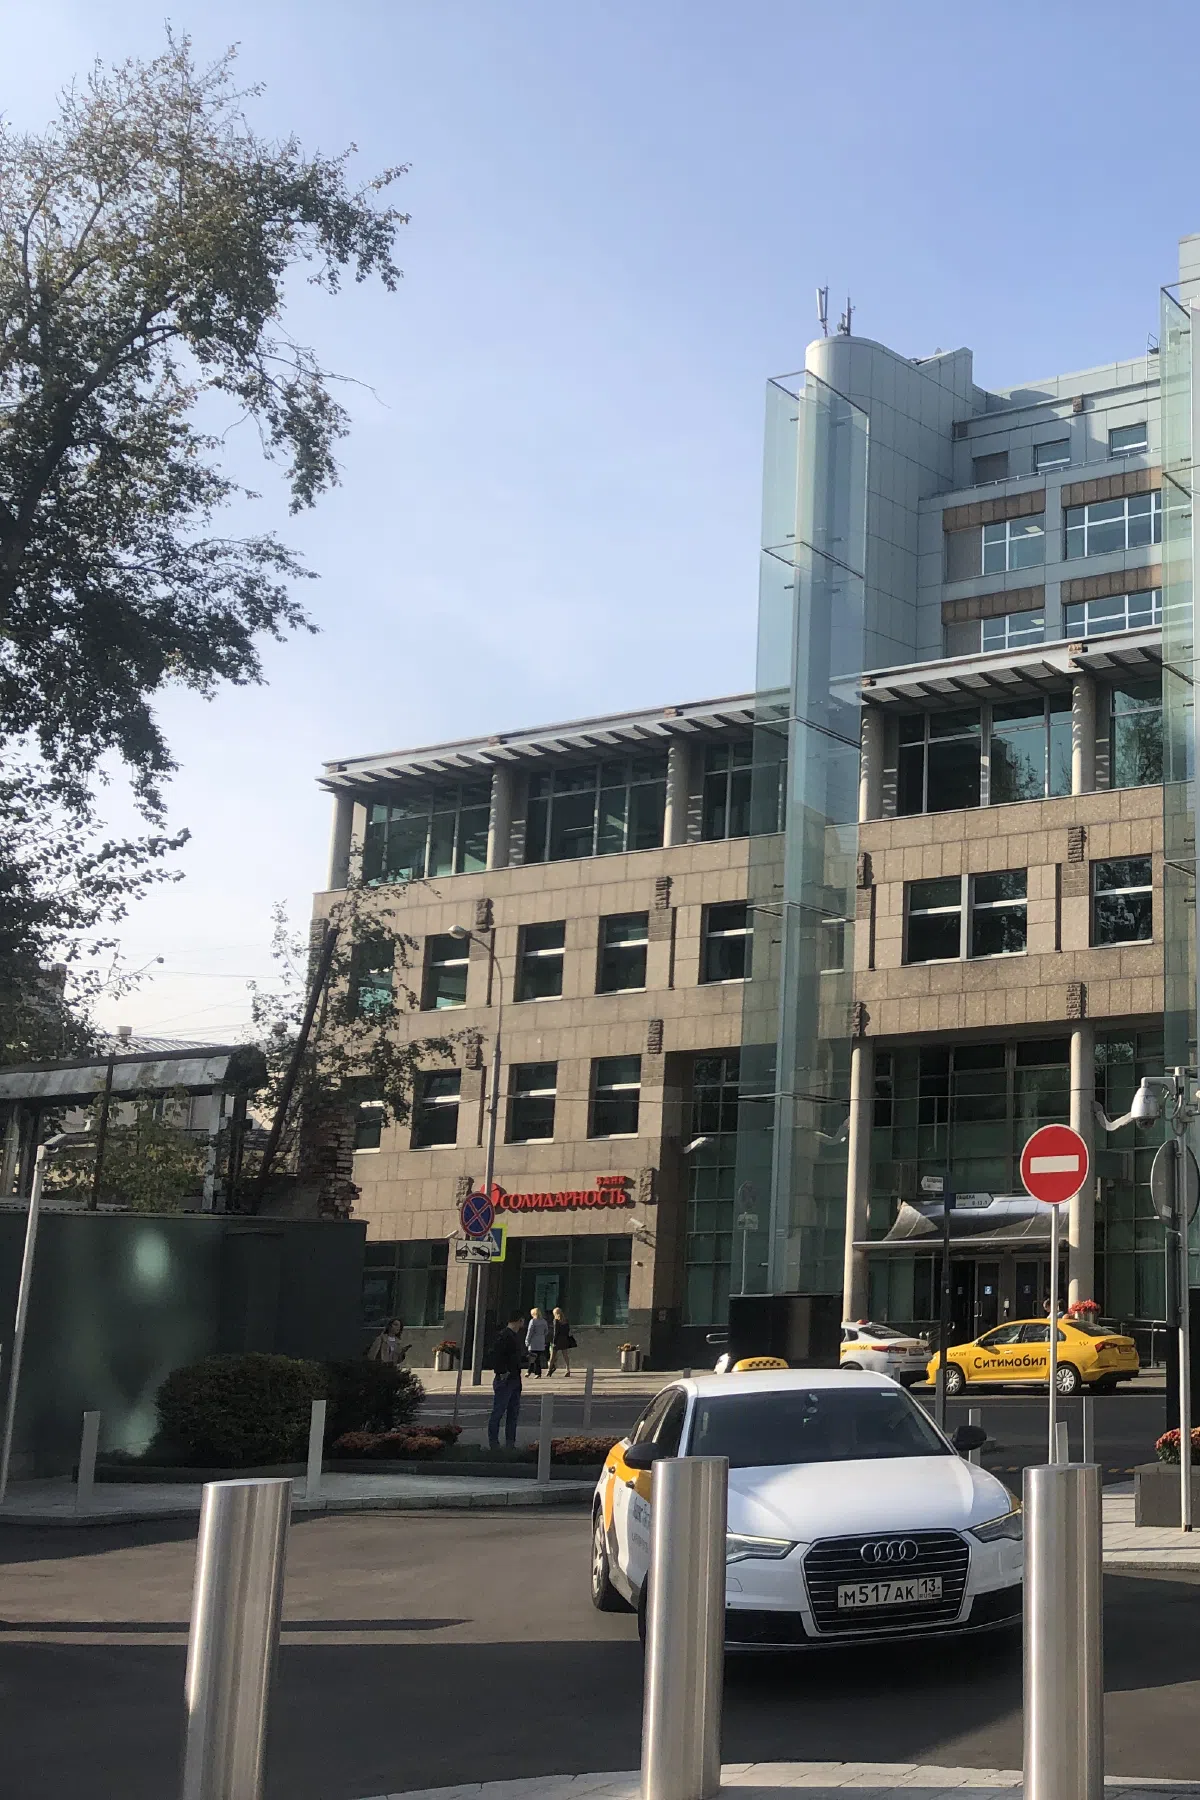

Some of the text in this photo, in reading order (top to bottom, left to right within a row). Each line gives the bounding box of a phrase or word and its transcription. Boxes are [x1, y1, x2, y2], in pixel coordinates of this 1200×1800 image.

[596, 1175, 626, 1185] БАНК
[500, 1188, 626, 1209] СОЛИДАРНОСТЬ
[973, 1354, 1047, 1370] Ситимобил
[920, 1578, 936, 1593] 13
